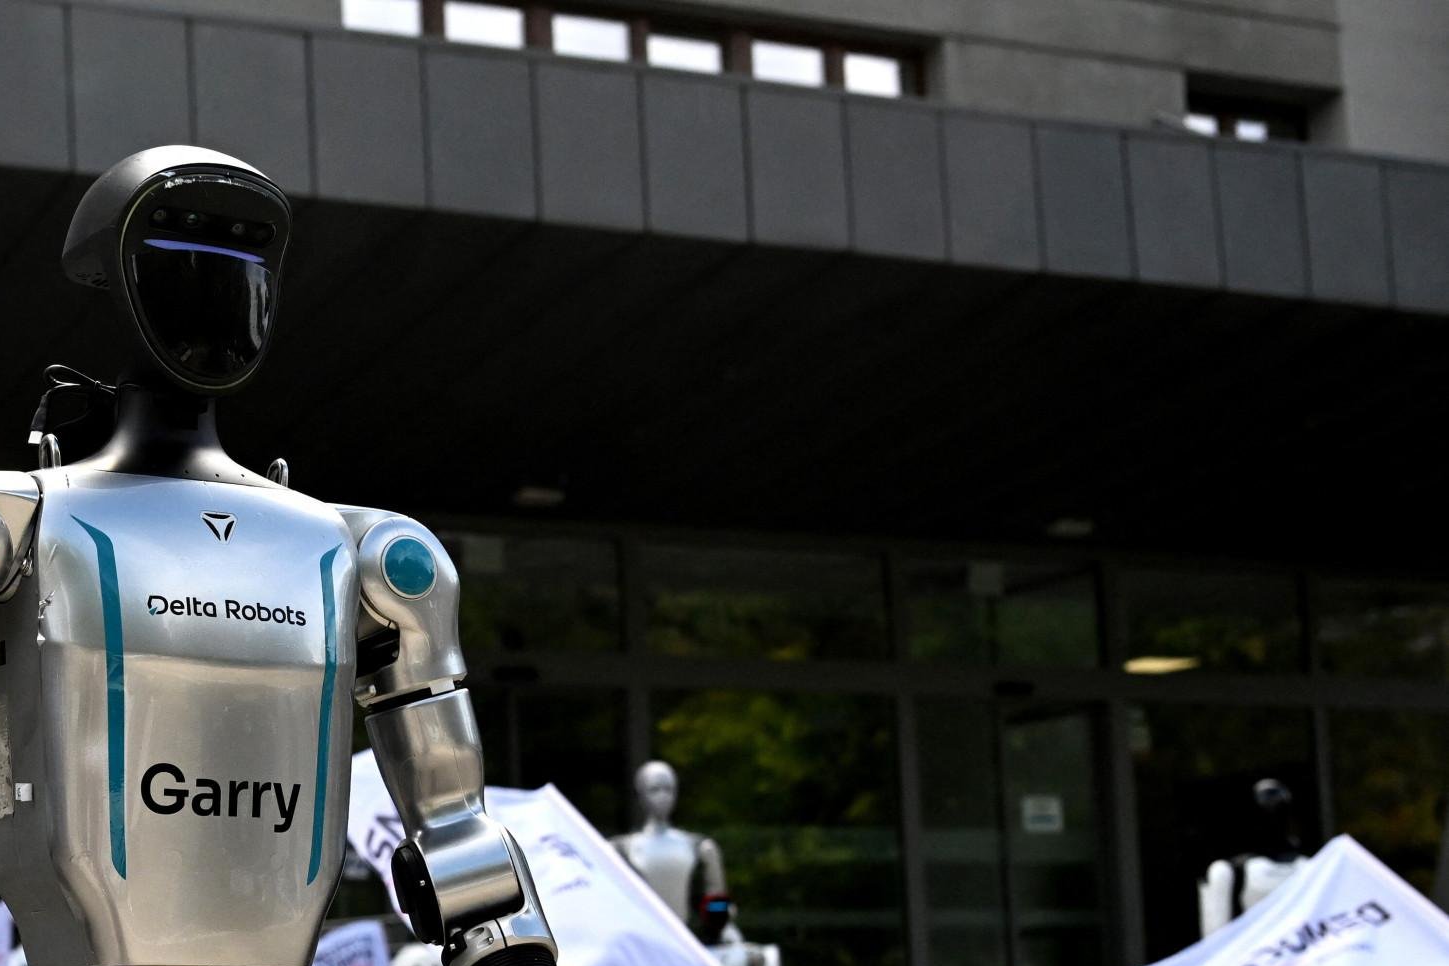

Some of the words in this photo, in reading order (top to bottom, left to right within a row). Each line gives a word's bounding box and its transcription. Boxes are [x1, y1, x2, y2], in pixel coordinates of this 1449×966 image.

[147, 595, 217, 617] Delta
[225, 599, 307, 627] Robots
[140, 762, 302, 833] Garry
